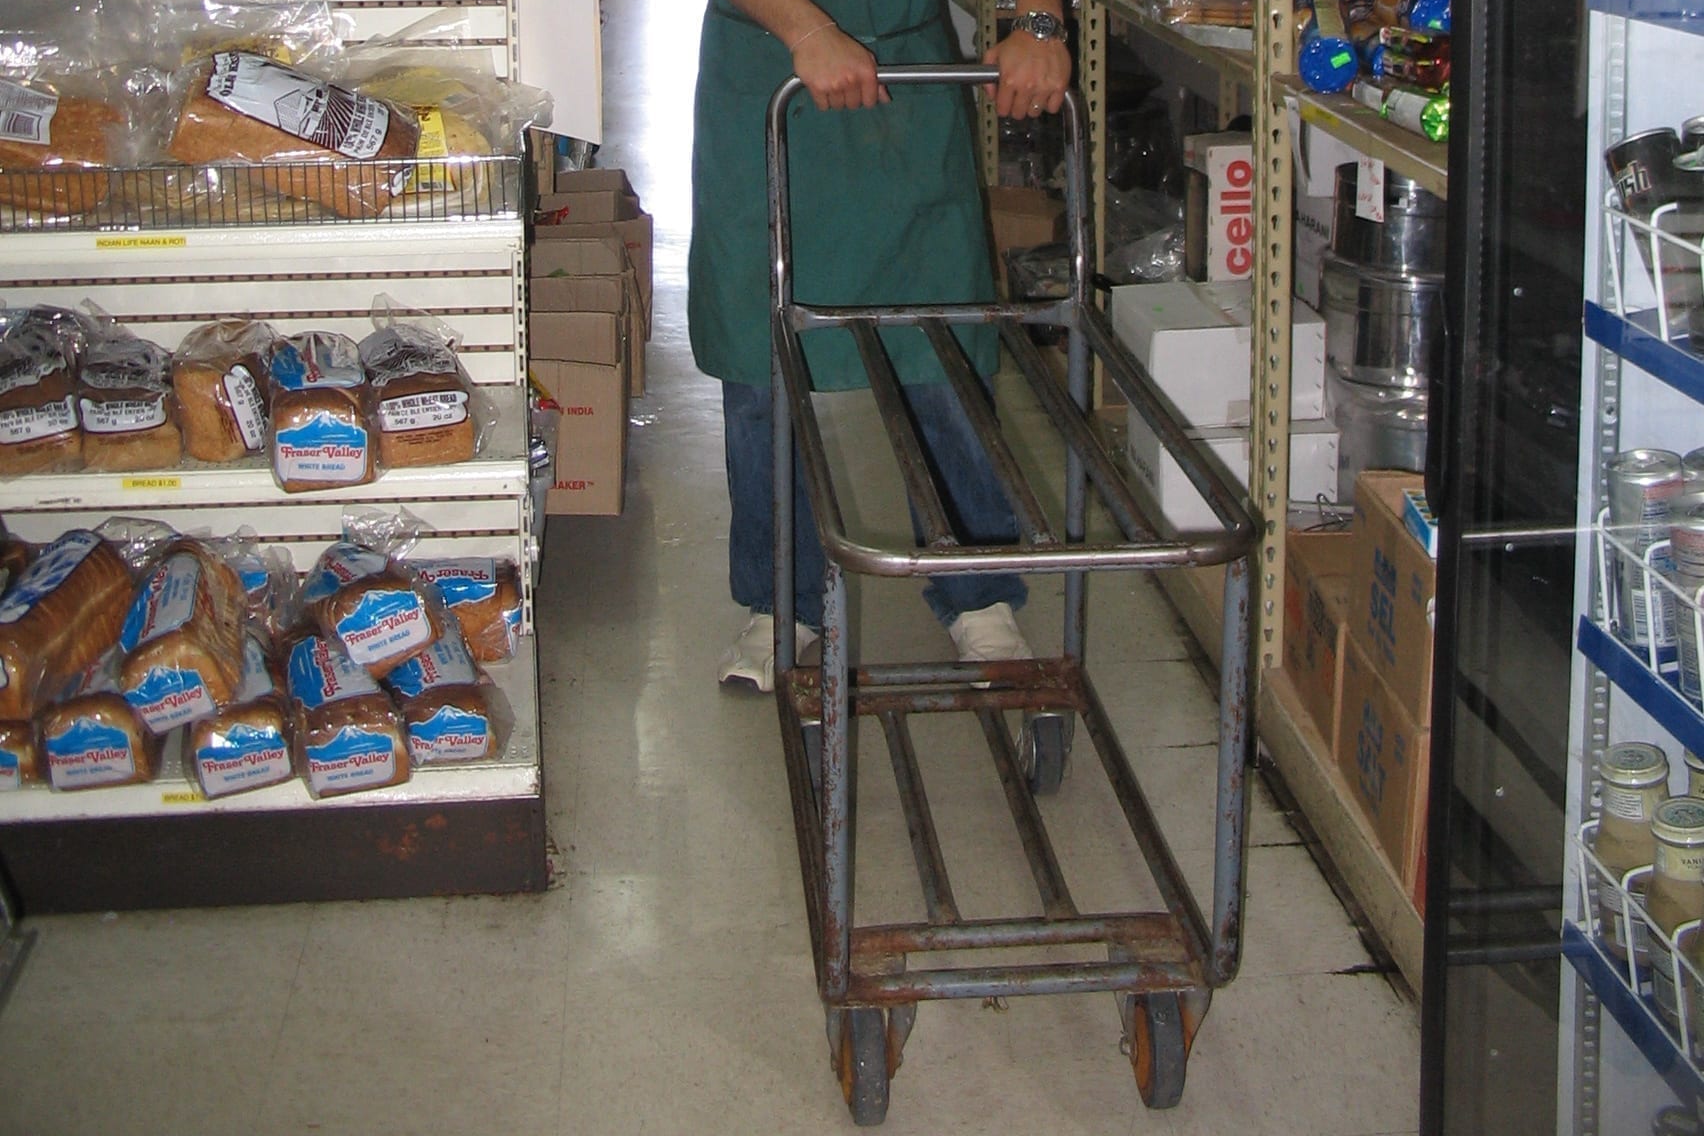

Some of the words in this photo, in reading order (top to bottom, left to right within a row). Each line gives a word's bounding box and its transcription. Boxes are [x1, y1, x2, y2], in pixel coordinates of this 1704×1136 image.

[366, 134, 378, 151] 567
[1221, 160, 1253, 275] cello
[567, 407, 594, 415] INDIA
[281, 446, 320, 459] Fraser
[322, 445, 363, 459] Valley
[322, 463, 345, 471] BREAD
[437, 568, 490, 581] Fraser
[344, 624, 383, 646] Fraser
[382, 608, 420, 630] Valley
[165, 686, 203, 709] Valley
[444, 735, 485, 747] Valley
[48, 753, 85, 766] Fraser
[87, 749, 128, 764] Valley
[203, 759, 242, 773] Fraser
[243, 749, 285, 765] Valley
[310, 760, 348, 774] Fraser
[348, 752, 390, 768] Valley
